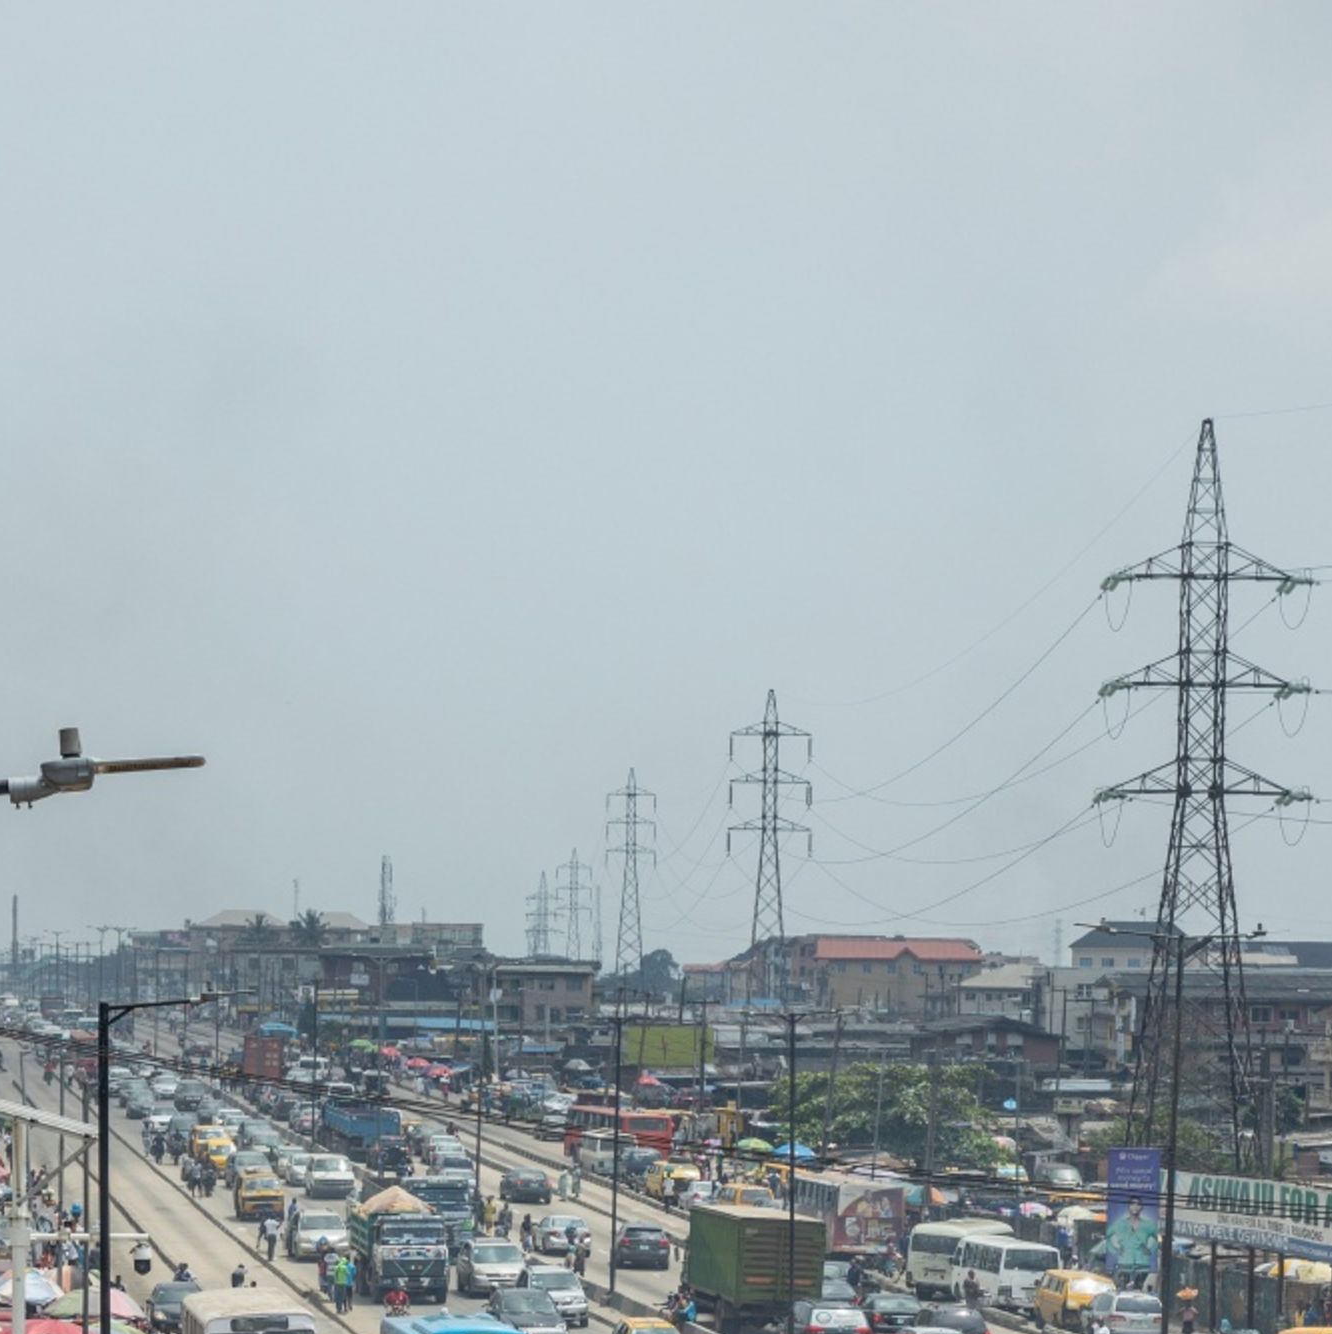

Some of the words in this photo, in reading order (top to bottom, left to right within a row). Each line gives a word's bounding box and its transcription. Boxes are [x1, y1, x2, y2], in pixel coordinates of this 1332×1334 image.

[1186, 1175, 1275, 1216] ASIWAJU
[1280, 1184, 1318, 1227] FOR
[1209, 1225, 1233, 1240] DELE
